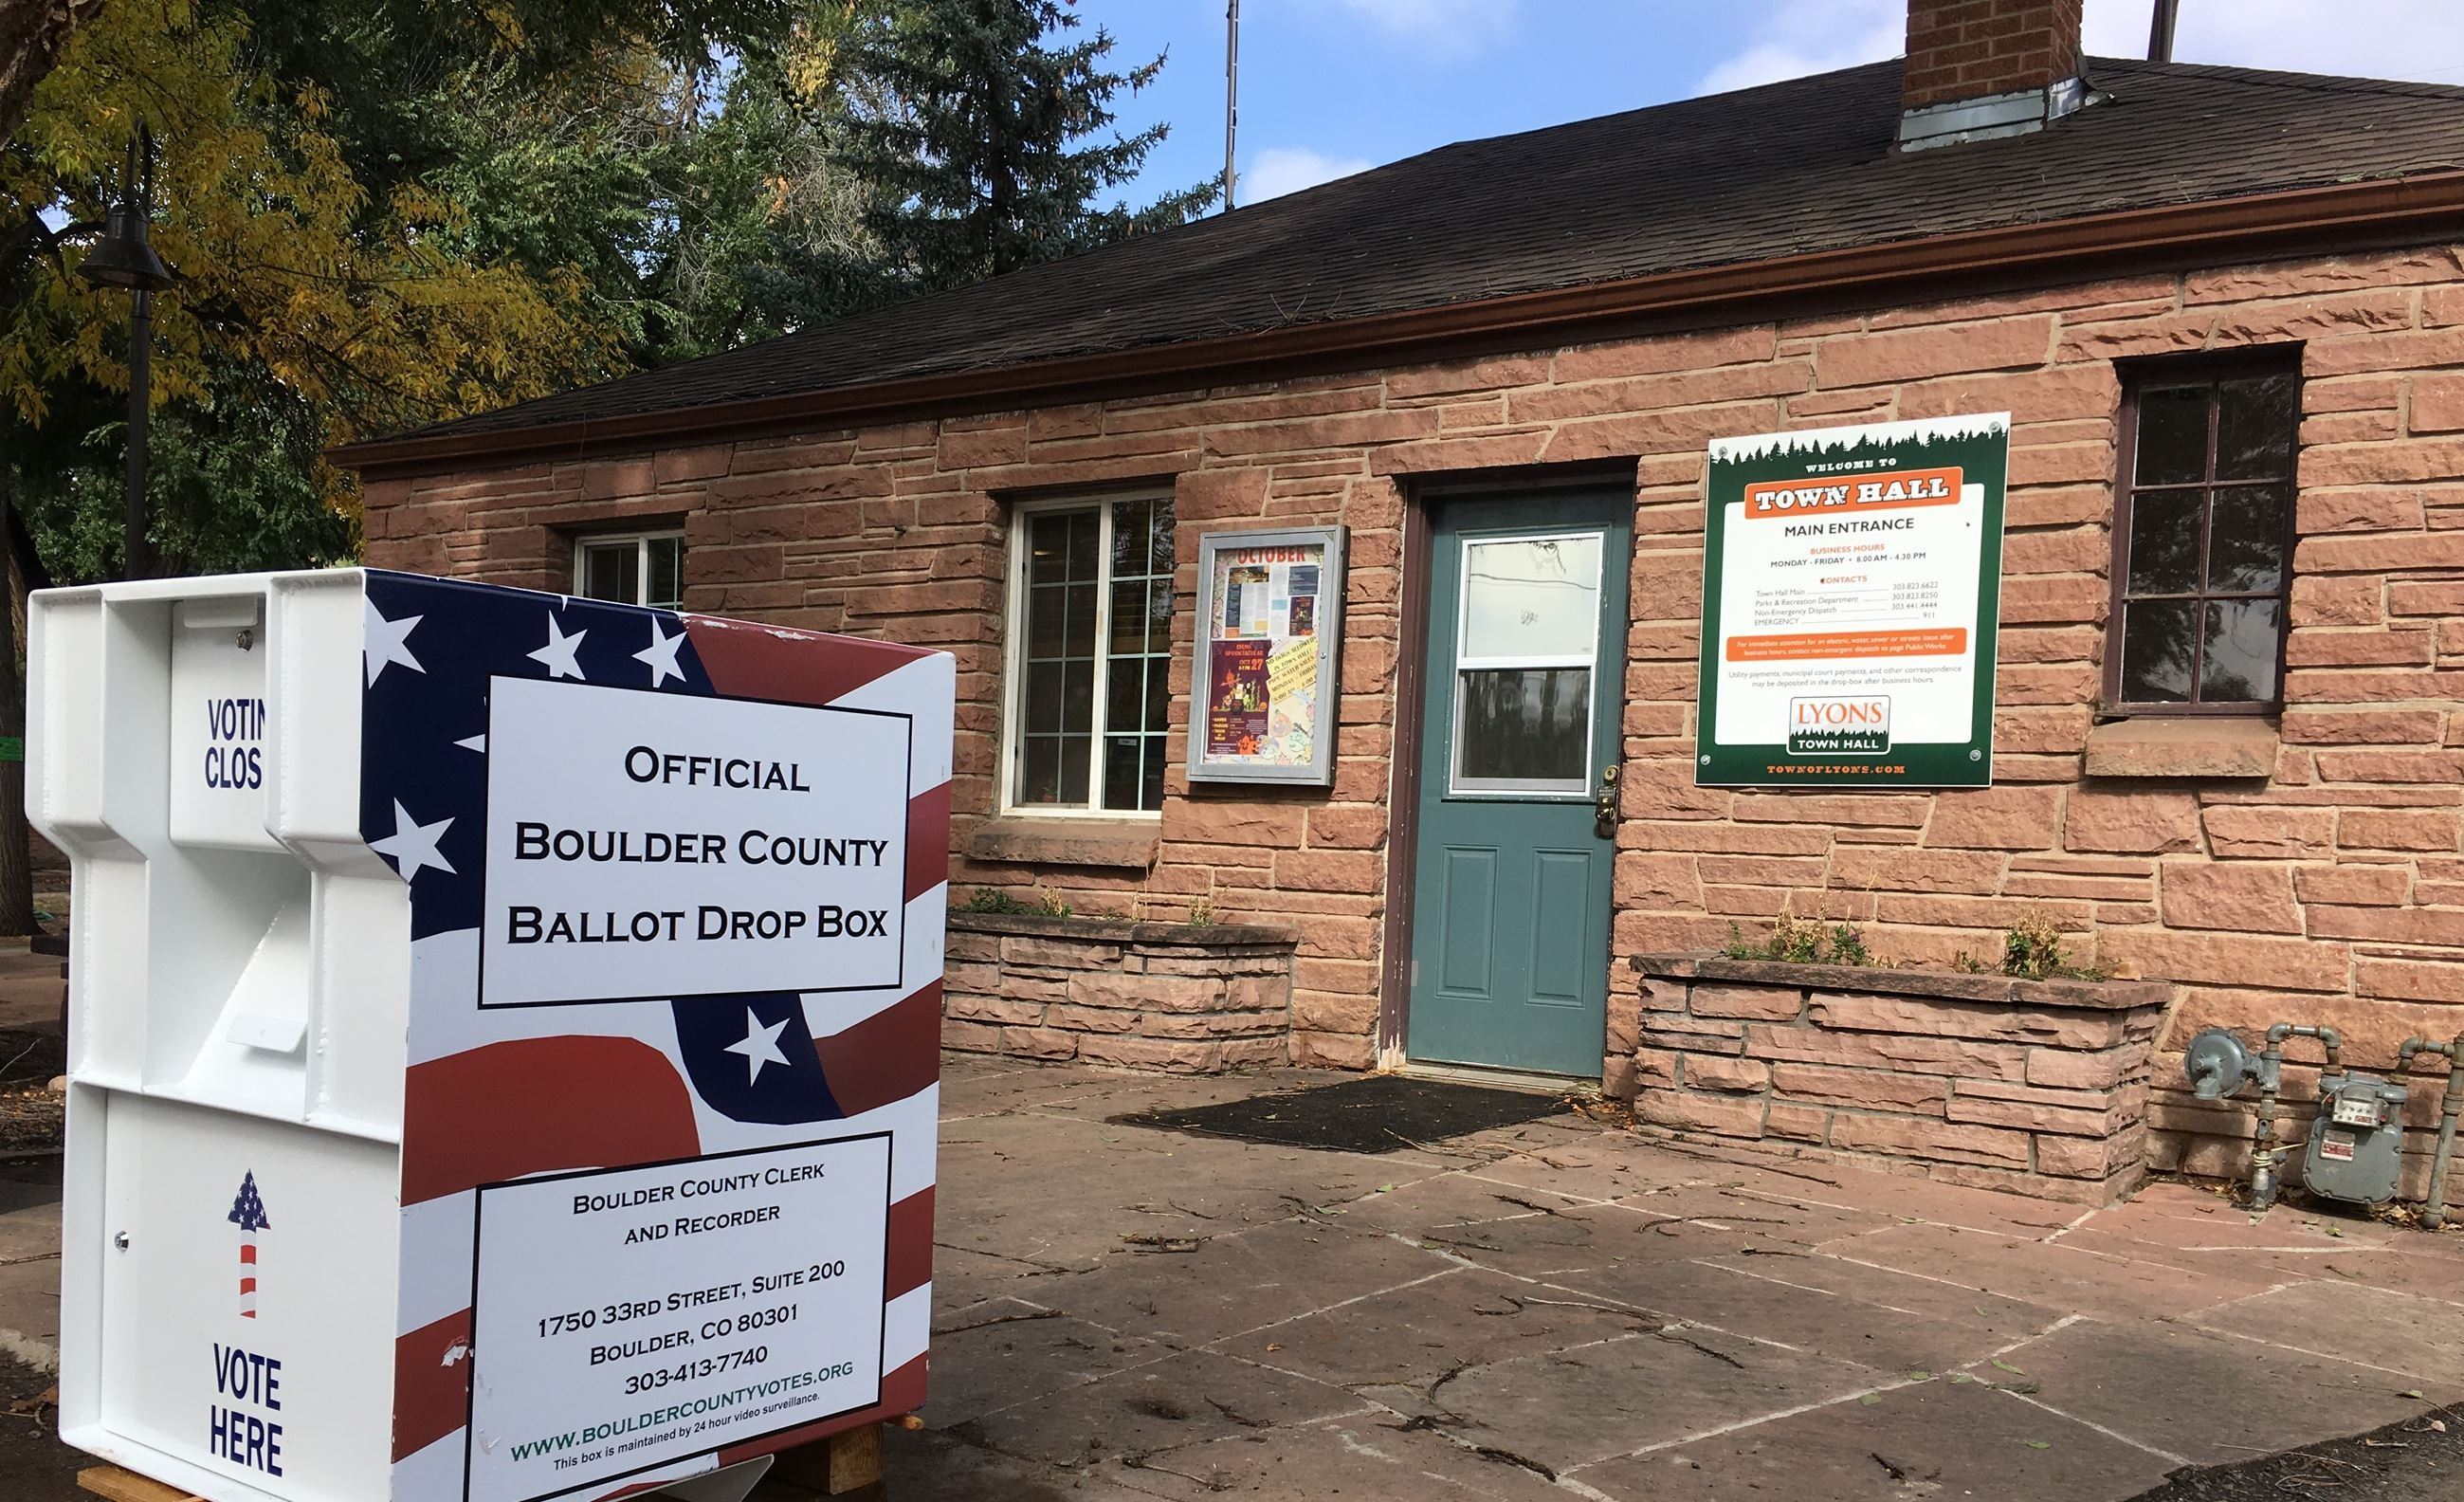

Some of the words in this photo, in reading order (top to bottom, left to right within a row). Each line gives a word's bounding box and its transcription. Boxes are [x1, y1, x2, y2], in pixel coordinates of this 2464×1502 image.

[1805, 460, 1873, 473] WELCOME
[1878, 457, 1897, 467] TO
[1754, 485, 1850, 511] TOWN
[1856, 477, 1949, 504] HALL
[1784, 522, 1824, 537] MAIN
[1829, 518, 1915, 535] ENTRANCE
[1236, 546, 1306, 564] OCTOBER
[1770, 559, 1808, 568] MONDAY
[1815, 557, 1845, 565] FRIDAY
[1810, 546, 1852, 555] BUSINESS
[1853, 543, 1886, 553] HOURS
[1819, 575, 1868, 584] CONTACTS
[1754, 608, 1807, 616] Non-Emergency
[1818, 596, 1859, 605] Department
[1754, 617, 1799, 626] EMERGENCY
[1251, 658, 1264, 670] 27
[1782, 669, 1813, 678] municipal
[1776, 680, 1808, 688] deposited
[1831, 678, 1862, 687] drop-box
[208, 698, 265, 741] VOTIN
[1798, 702, 1883, 724] LYONS
[1798, 740, 1839, 749] TOWN
[1843, 739, 1879, 749] HALL
[205, 746, 262, 790] CLOS
[625, 745, 811, 793] OFFICIAL
[1767, 765, 1906, 775] TOWNOFLYONS.COM
[514, 821, 727, 865] BOULDER
[739, 830, 888, 867] COUNTY
[507, 906, 686, 944] BALLOT
[697, 906, 807, 941] DROP
[817, 905, 888, 939] BOX
[573, 1185, 675, 1215] BOULDER
[680, 1172, 760, 1200] COUNTY
[764, 1163, 825, 1185] CLERK
[624, 1223, 668, 1245] AND
[675, 1205, 781, 1236] RECORDER
[538, 1310, 596, 1338] 1750
[601, 1299, 661, 1325] 33RD
[666, 1282, 746, 1311] STREET,
[752, 1270, 805, 1293] SUITE
[809, 1259, 846, 1283] 200
[590, 1329, 695, 1366] BOULDER,
[700, 1318, 732, 1341] CO
[738, 1304, 799, 1331] 80301
[213, 1343, 282, 1411] VOTE
[624, 1346, 768, 1395] 303-413-7740
[510, 1362, 853, 1461] WWW.BOULDERCOUNTYVOTES.ORG
[210, 1404, 283, 1477] HERE
[554, 1456, 577, 1471] This
[581, 1450, 602, 1463] box
[605, 1447, 614, 1457] is
[617, 1432, 676, 1454] maintained
[678, 1426, 691, 1438] by
[694, 1421, 706, 1433] 24
[708, 1415, 732, 1429] hour
[735, 1408, 760, 1422] video
[762, 1392, 820, 1415] surveillance.
